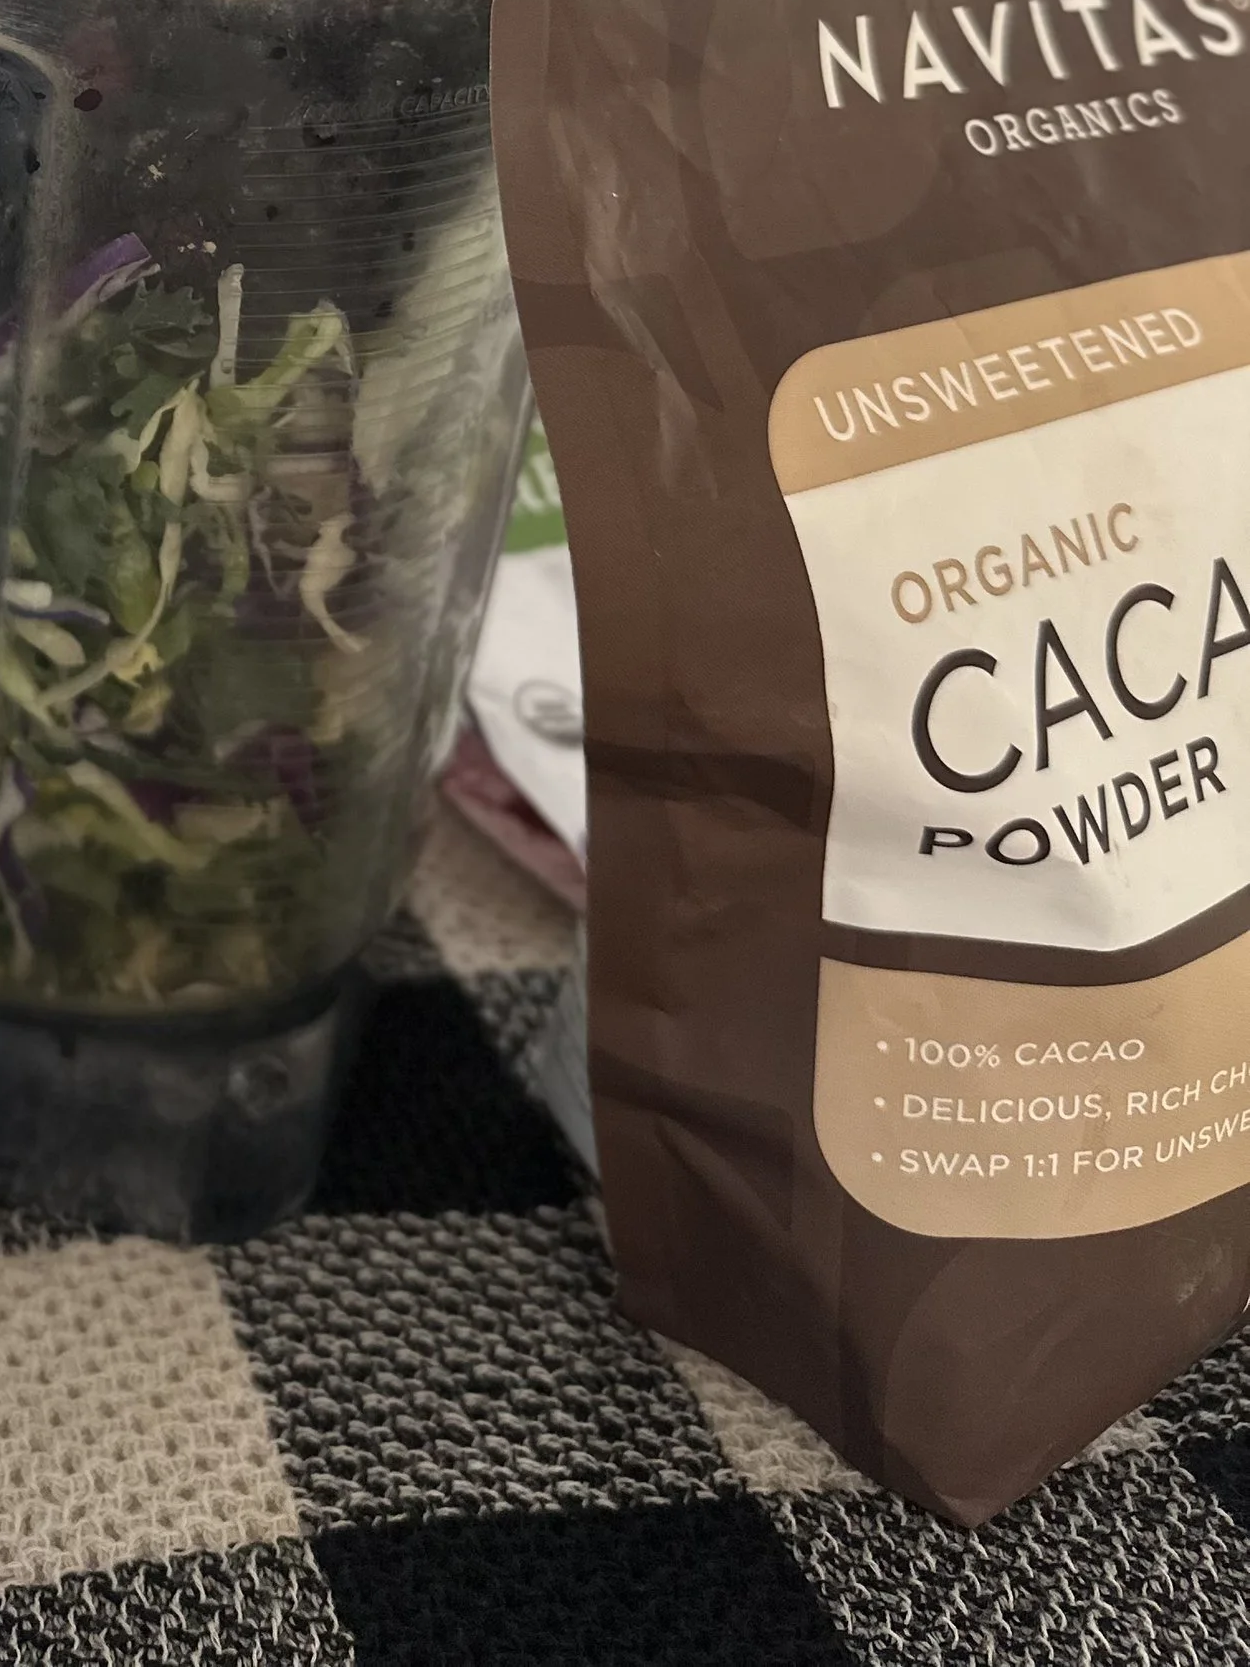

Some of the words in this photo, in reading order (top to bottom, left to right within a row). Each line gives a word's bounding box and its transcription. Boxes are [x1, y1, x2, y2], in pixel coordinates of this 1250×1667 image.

[964, 89, 1181, 156] ORGANICS
[813, 307, 1203, 442] UNSWEETENED
[890, 502, 1140, 624] ORGANIC
[917, 735, 1228, 866] POWDER
[904, 1036, 1001, 1069] 100%
[1014, 1038, 1146, 1067] CACAO
[902, 1092, 1112, 1124] DELICIOUS,
[1125, 1078, 1201, 1116] RICH
[1209, 1061, 1250, 1095] CH
[899, 1148, 1011, 1178] SWAP
[1022, 1152, 1059, 1178] 1:1
[1072, 1145, 1144, 1175] FOR
